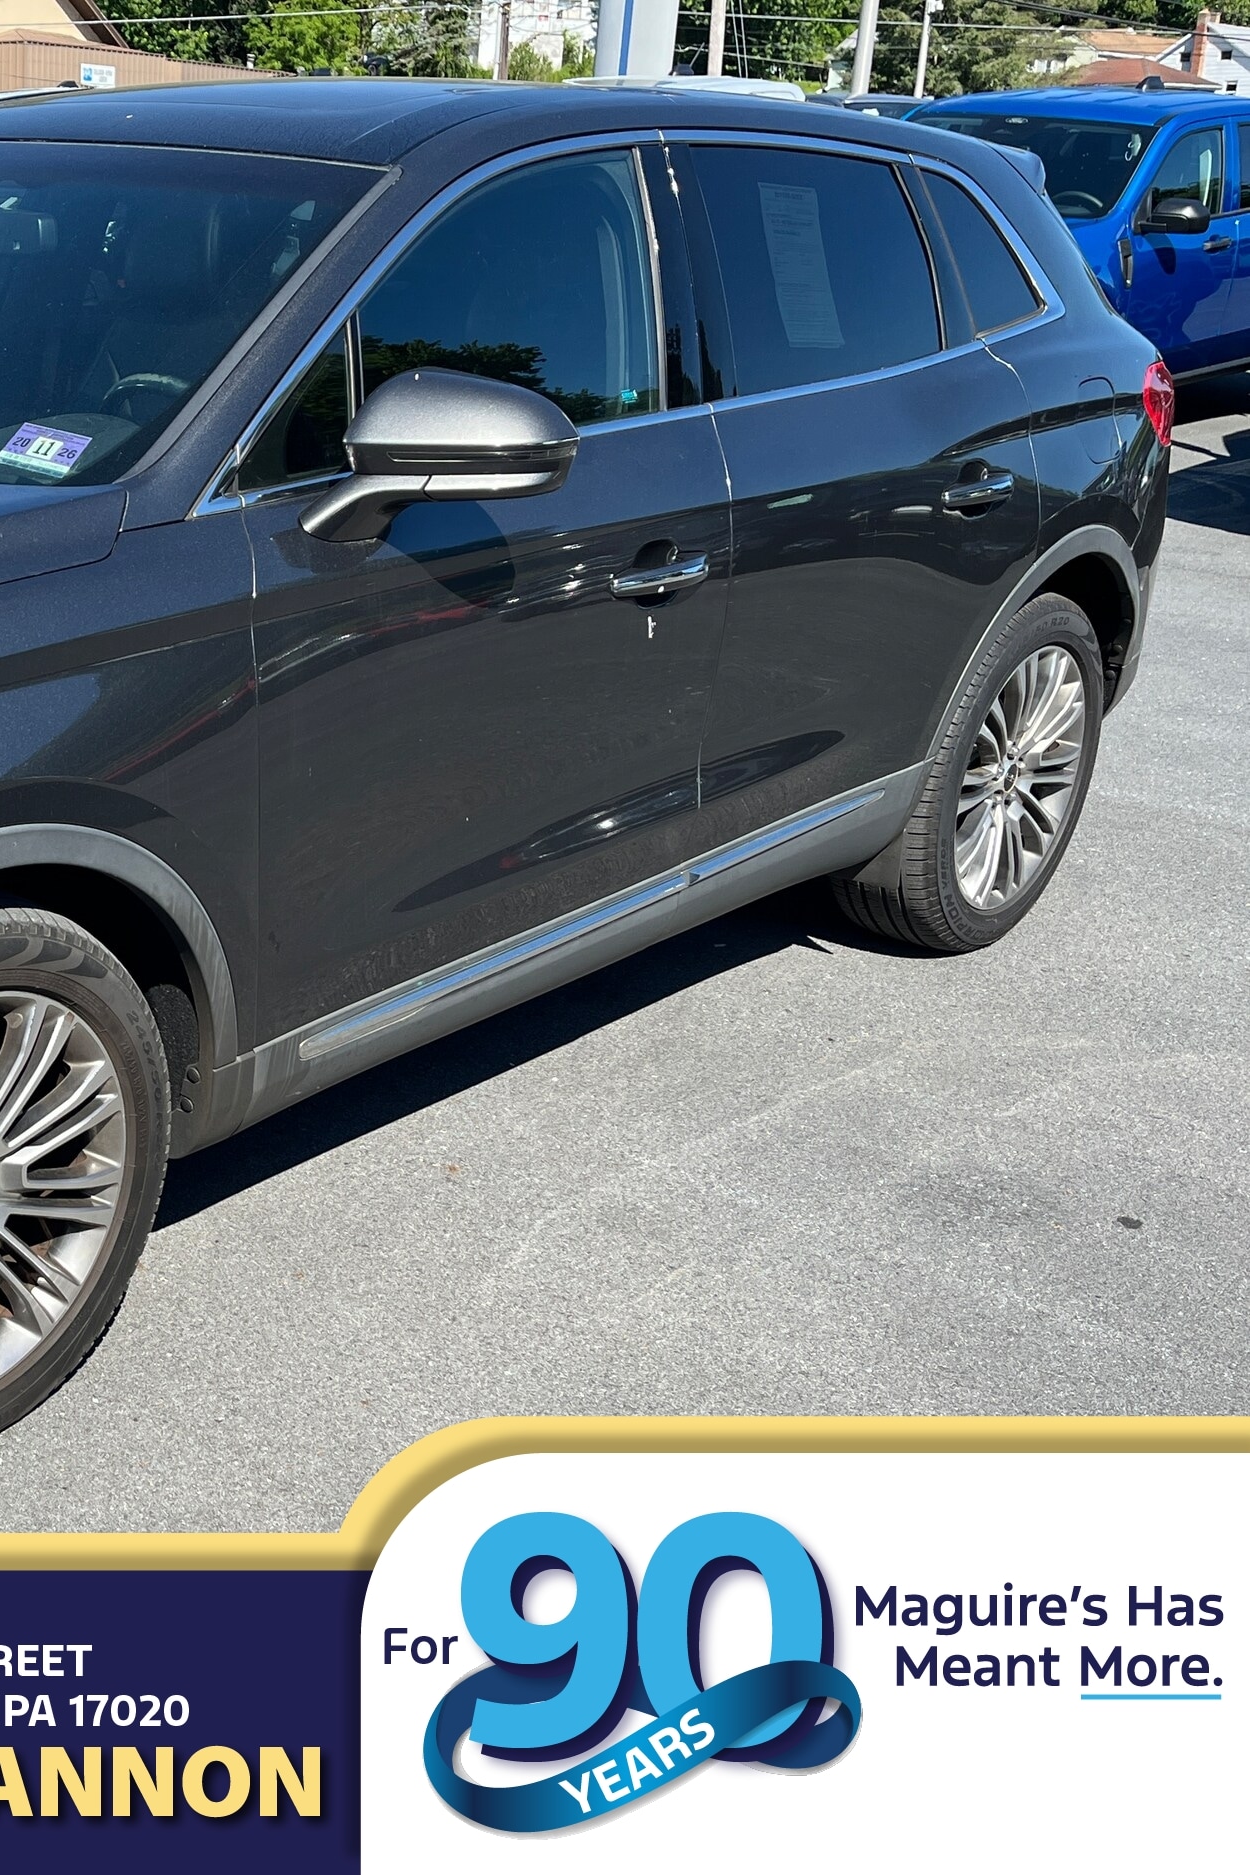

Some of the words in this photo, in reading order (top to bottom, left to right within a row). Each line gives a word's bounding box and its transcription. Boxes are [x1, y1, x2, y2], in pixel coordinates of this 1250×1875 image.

[12, 436, 31, 448] 20
[32, 440, 56, 457] 11
[57, 447, 78, 459] 26
